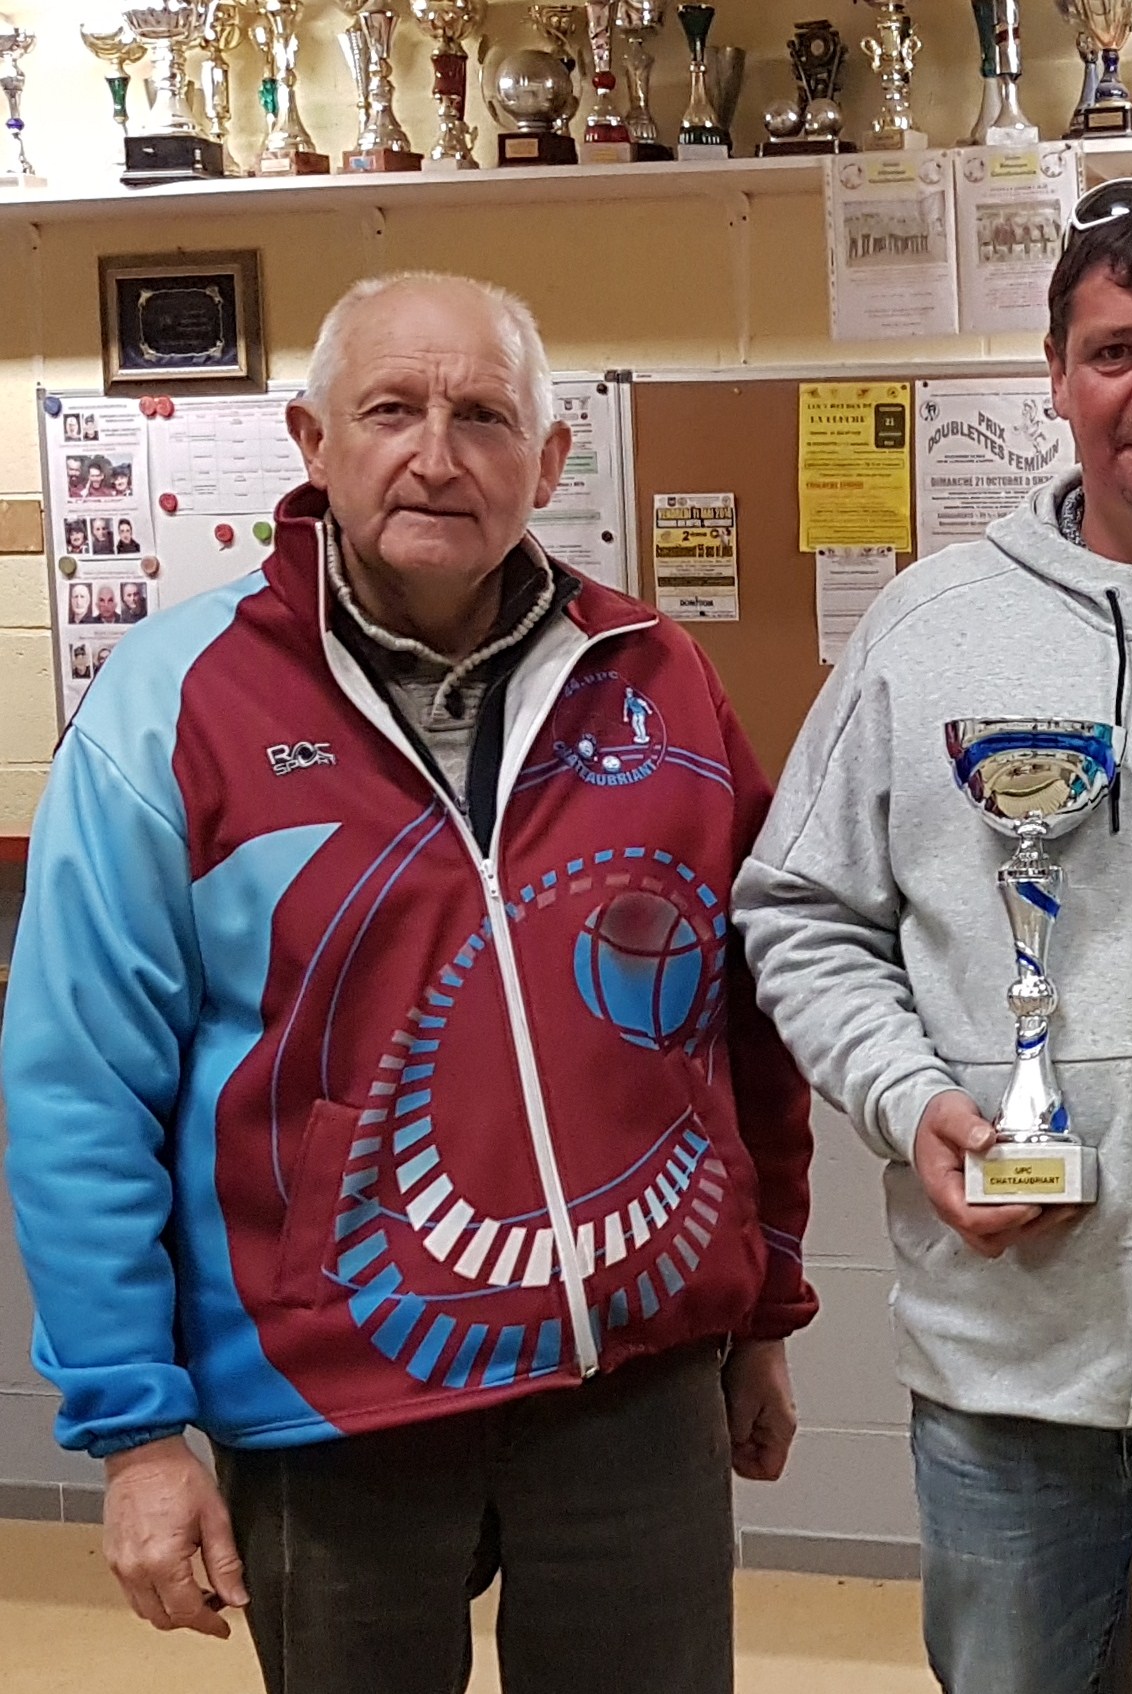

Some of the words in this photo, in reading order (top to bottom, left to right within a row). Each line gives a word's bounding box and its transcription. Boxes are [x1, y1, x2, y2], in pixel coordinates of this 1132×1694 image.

[978, 411, 1006, 443] PRIX
[928, 421, 1005, 460] DOUBLETTES
[1008, 438, 1059, 471] FEMININ
[975, 476, 984, 486] 21
